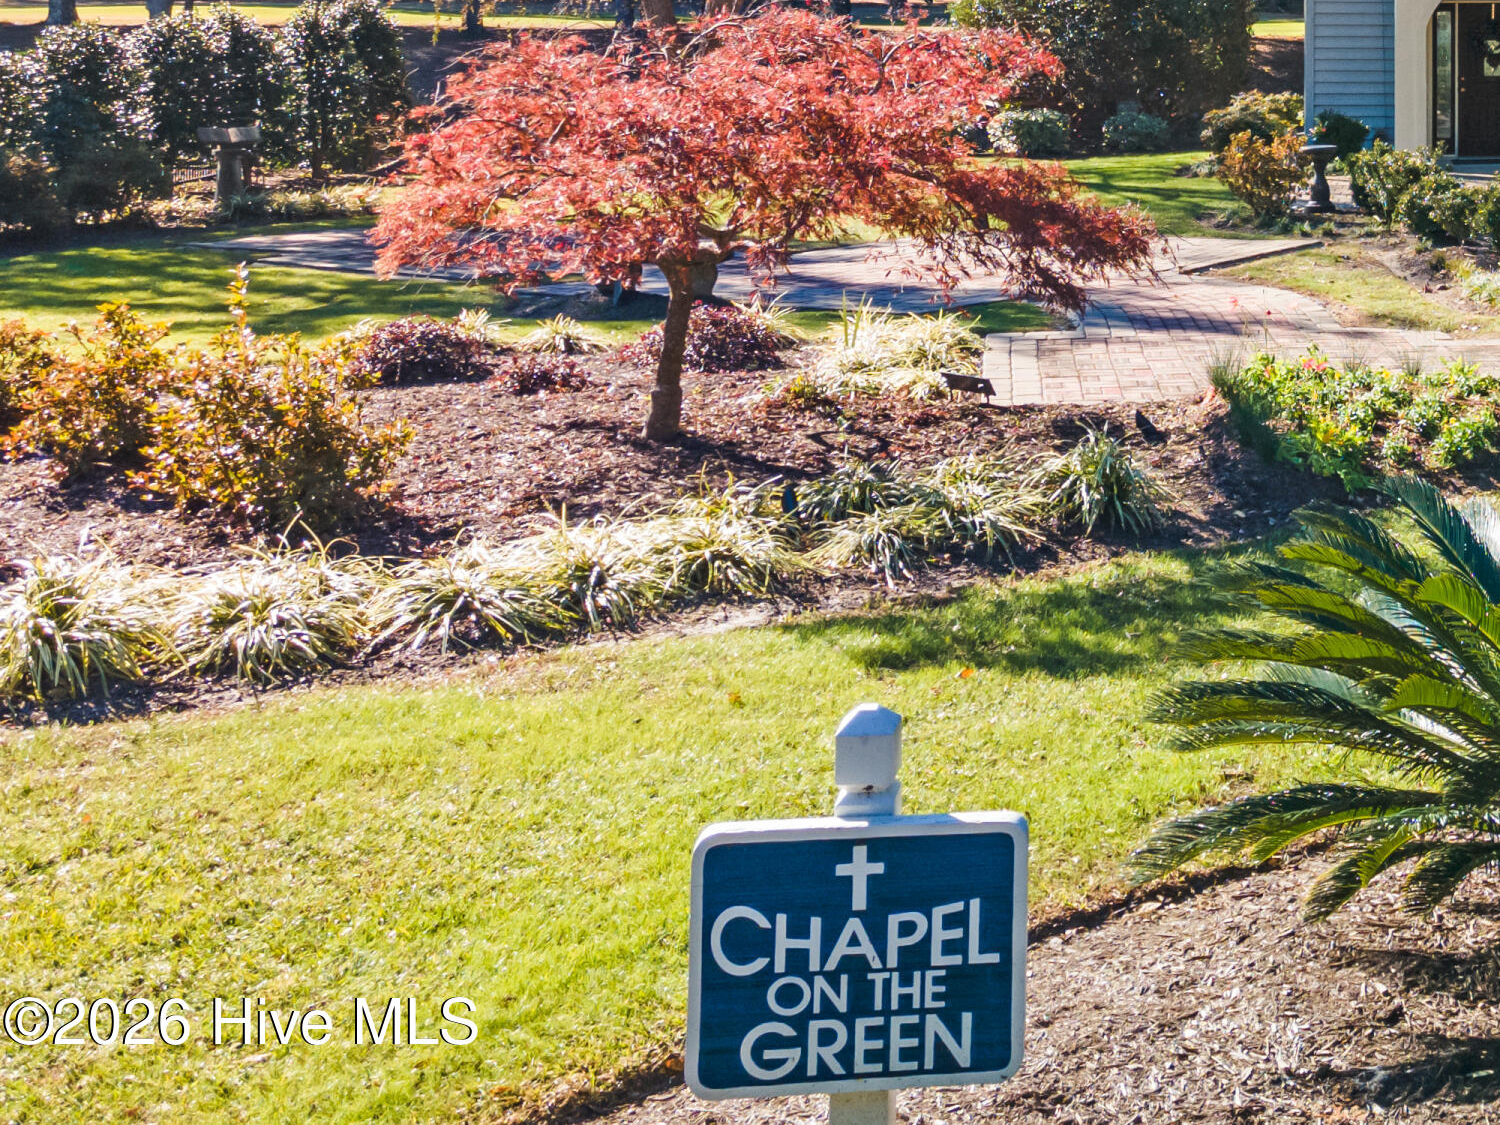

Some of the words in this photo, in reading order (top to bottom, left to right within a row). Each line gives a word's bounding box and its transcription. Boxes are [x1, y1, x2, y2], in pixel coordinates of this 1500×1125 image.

[710, 897, 1001, 977] CHAPEL
[766, 974, 849, 1017] ON
[866, 969, 947, 1011] THE
[739, 1012, 973, 1081] GREEN
